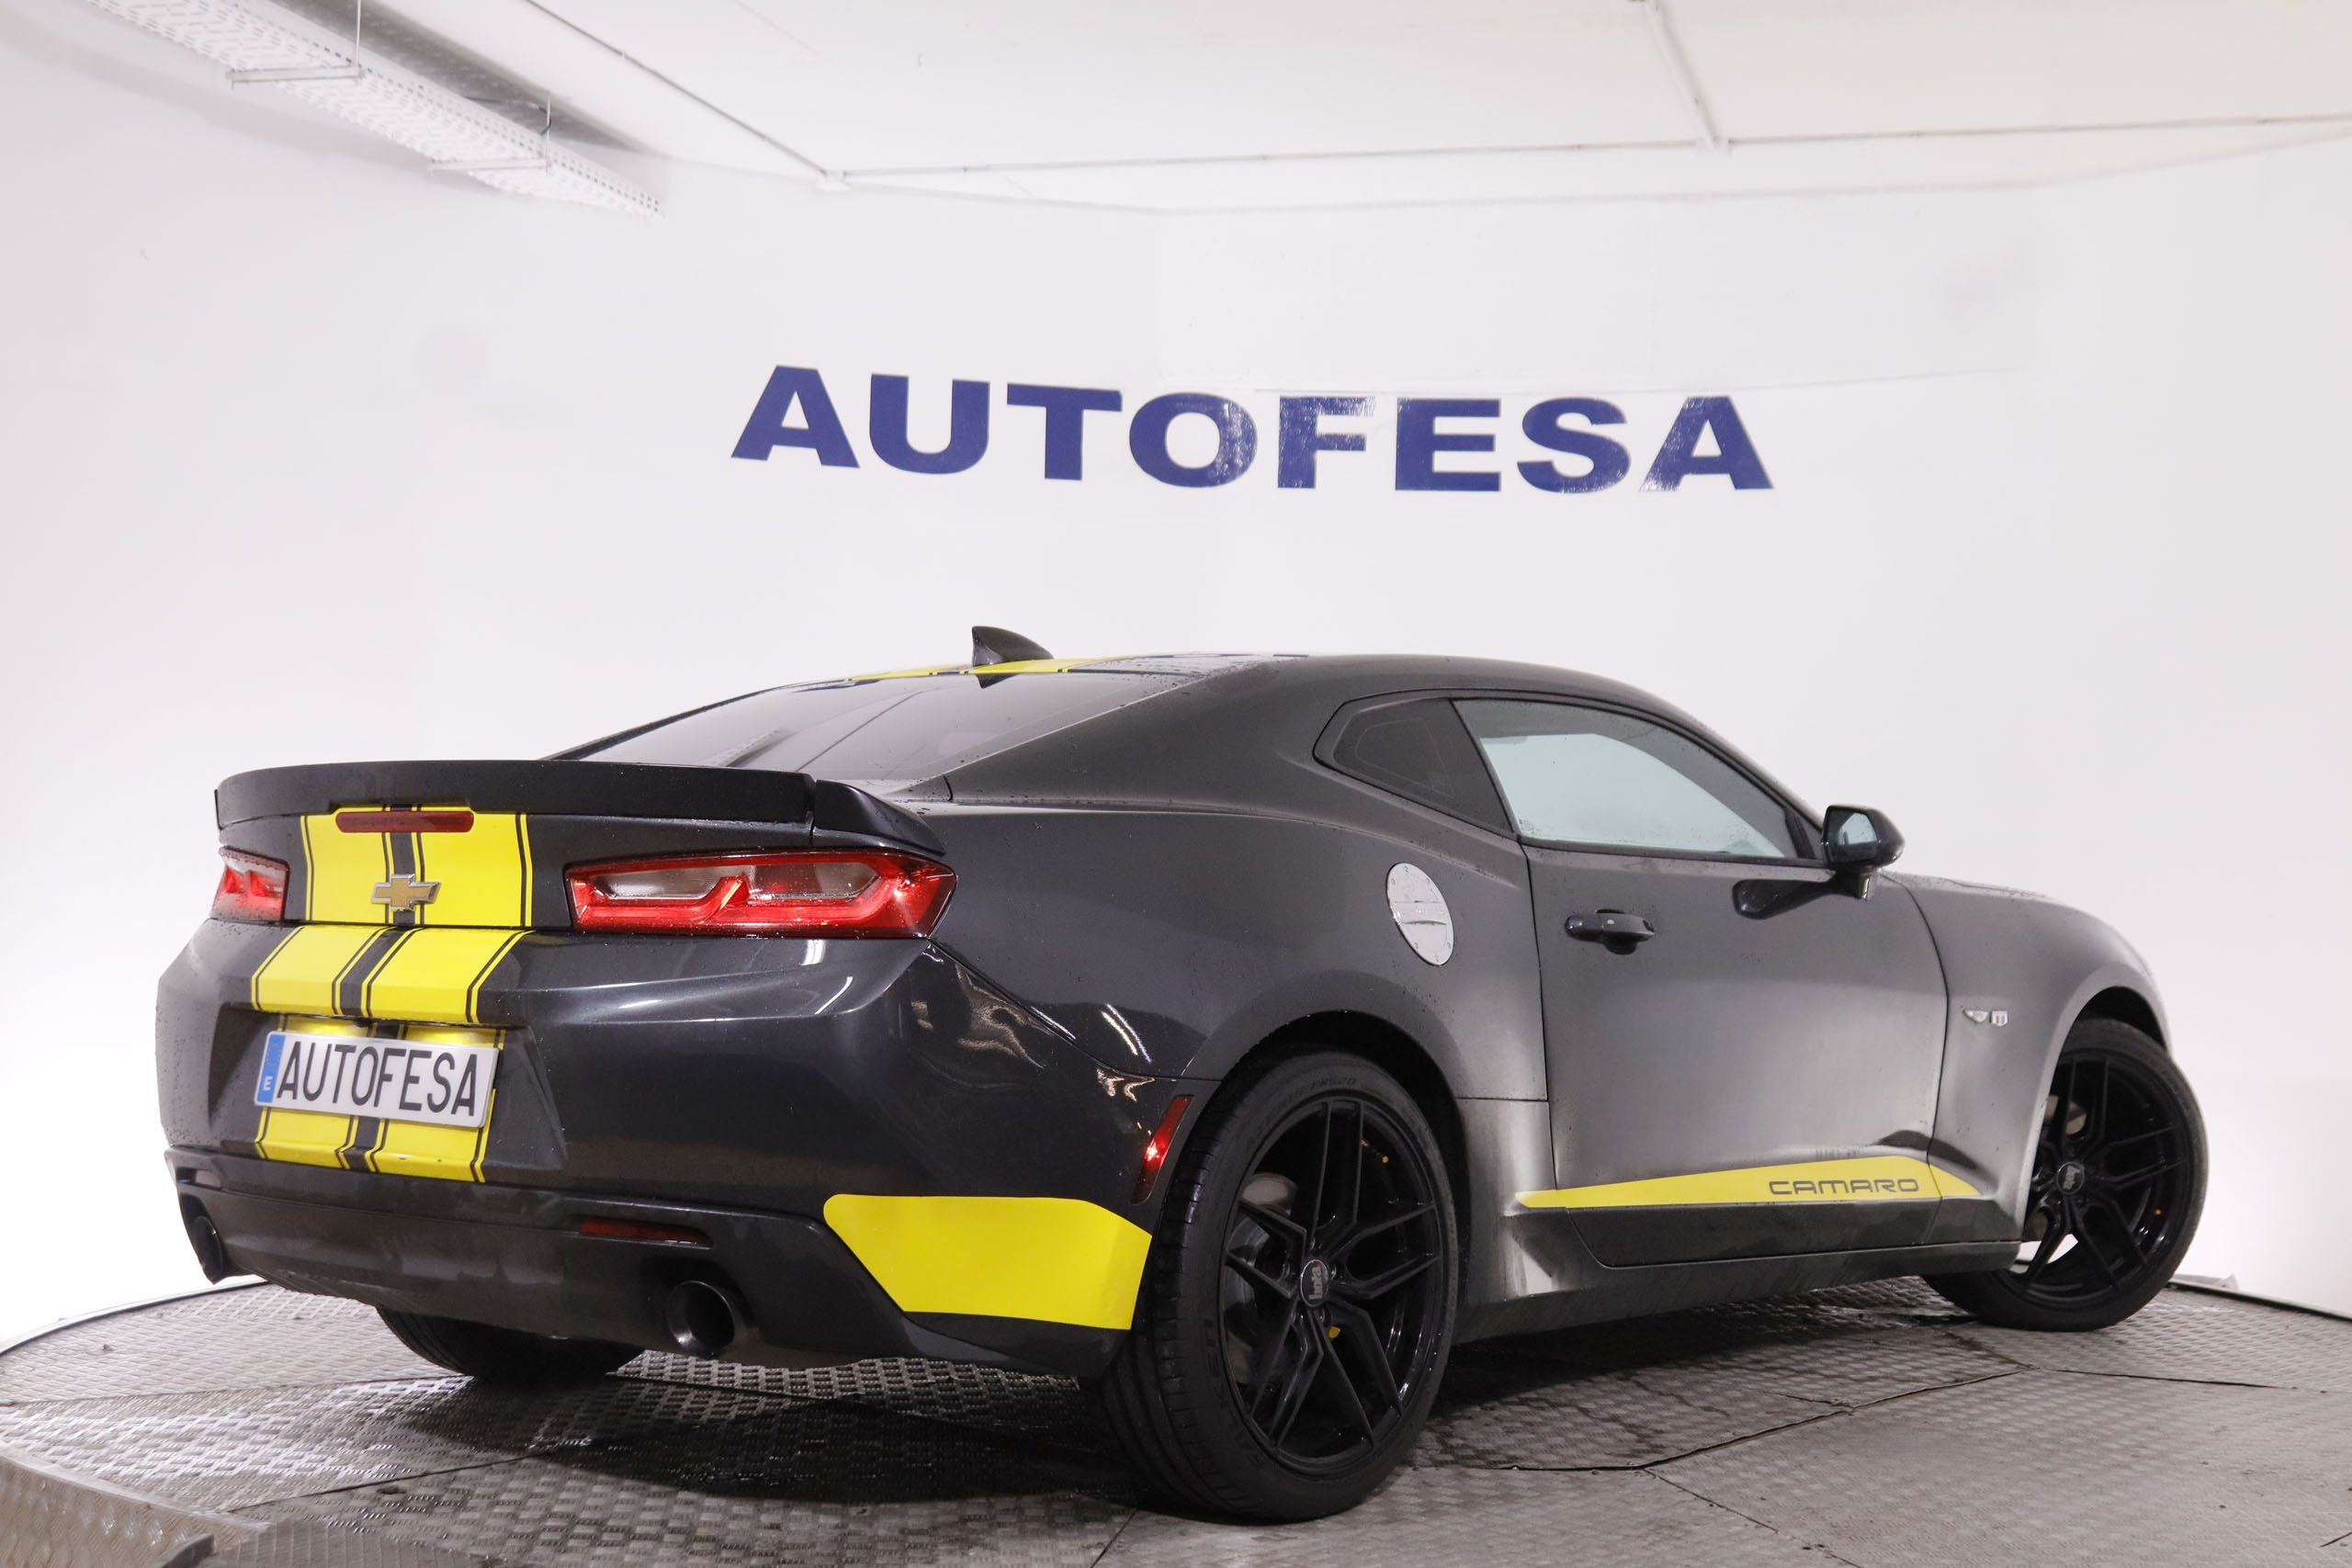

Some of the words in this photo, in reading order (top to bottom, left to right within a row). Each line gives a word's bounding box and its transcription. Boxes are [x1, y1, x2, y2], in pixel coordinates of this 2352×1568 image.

[730, 364, 1774, 493] AUTOFESA
[263, 1076, 273, 1091] E
[277, 1041, 478, 1117] AUTOFESA
[1769, 1179, 1919, 1195] CAMARO
